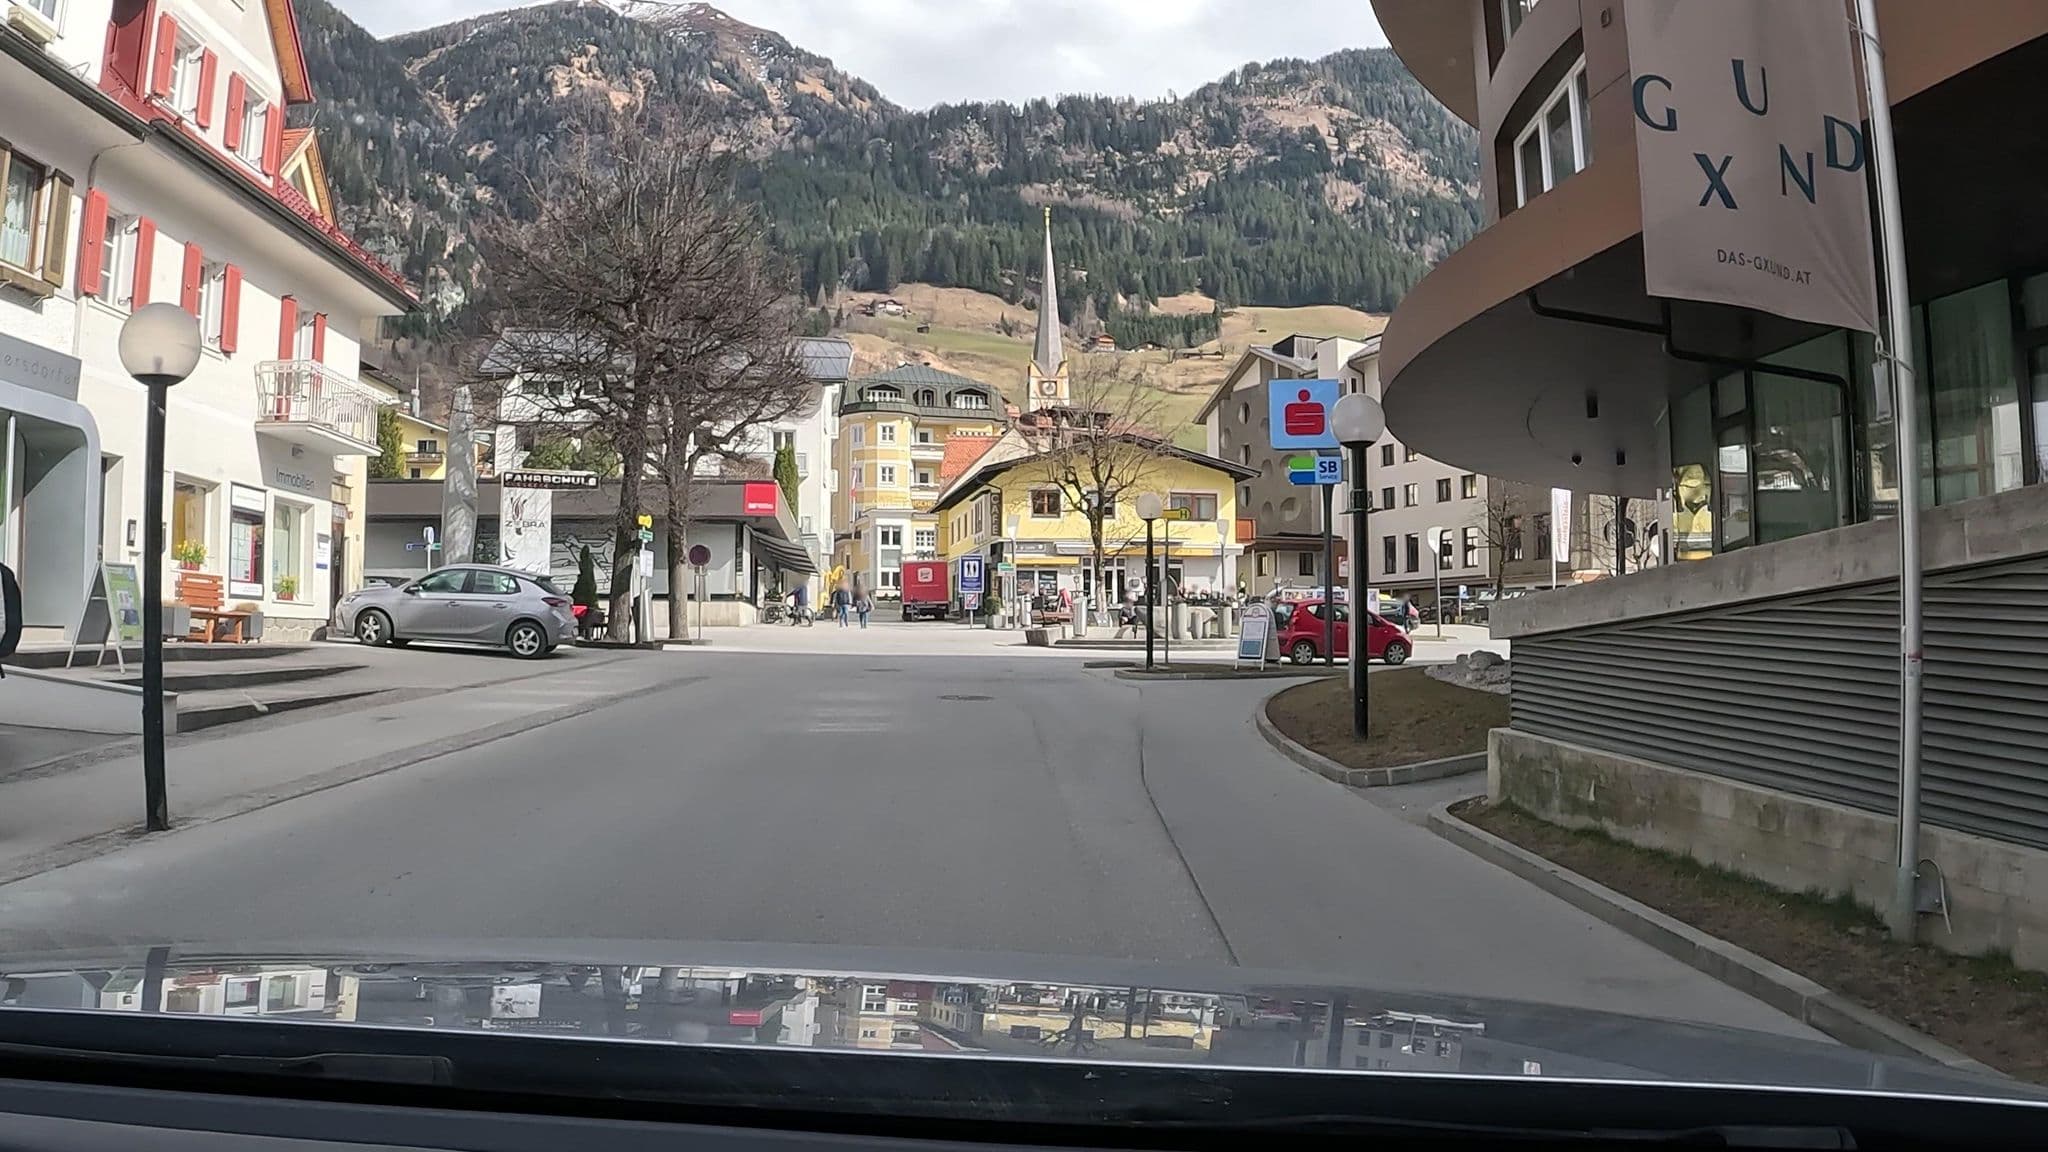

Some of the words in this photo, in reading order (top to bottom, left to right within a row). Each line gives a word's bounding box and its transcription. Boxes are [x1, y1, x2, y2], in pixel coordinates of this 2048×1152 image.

[1717, 248, 1812, 285] DAS-GXUND.AT
[0, 353, 79, 388] ersdorfer
[1318, 460, 1338, 474] SB
[504, 472, 598, 487] FAHRSCHULE
[1180, 509, 1188, 519] H
